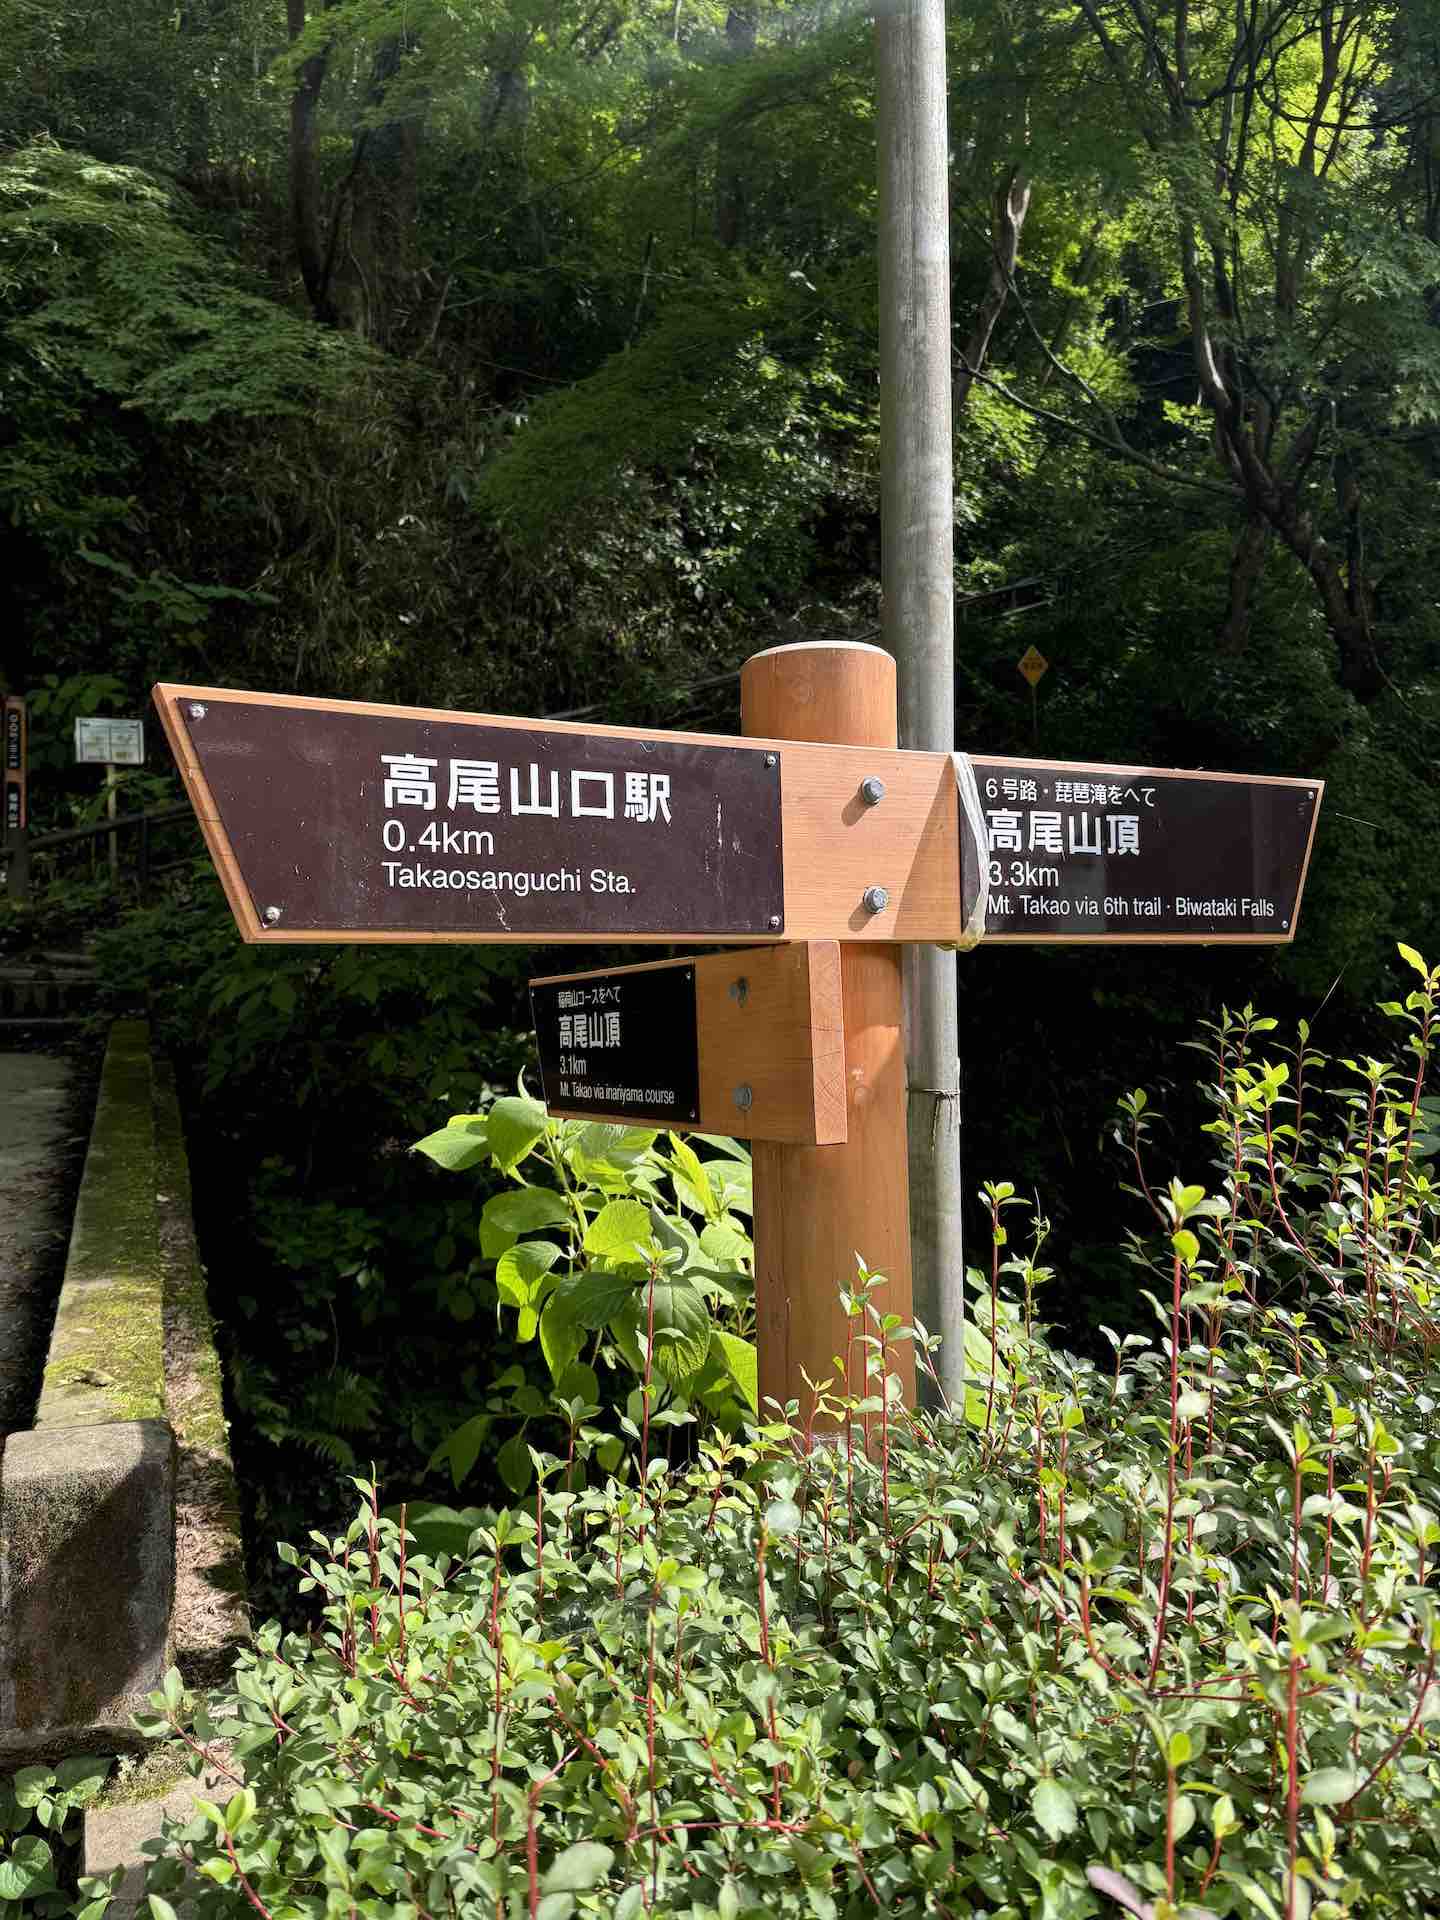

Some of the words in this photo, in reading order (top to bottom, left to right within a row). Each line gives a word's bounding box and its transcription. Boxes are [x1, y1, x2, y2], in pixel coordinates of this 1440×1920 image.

[381, 753, 672, 825] 高尾山口駅
[382, 819, 494, 855] 0.4km
[986, 808, 1140, 856] 高尾山頂
[381, 862, 581, 896] Takaosanguchi
[590, 868, 636, 894] Sta.
[989, 860, 1059, 887] 3.3km
[988, 894, 1015, 915] Mt.
[1020, 894, 1070, 916] Takao
[1075, 896, 1099, 916] via
[1103, 896, 1129, 916] 6th
[1133, 896, 1161, 917] trail
[1175, 897, 1237, 917] Biwataki
[1241, 898, 1274, 917] Falls
[558, 1011, 621, 1048] 高尾山頂
[559, 1054, 587, 1076] 3.1km
[572, 1081, 593, 1099] Takao
[593, 1083, 605, 1099] via
[644, 1088, 675, 1104] course
